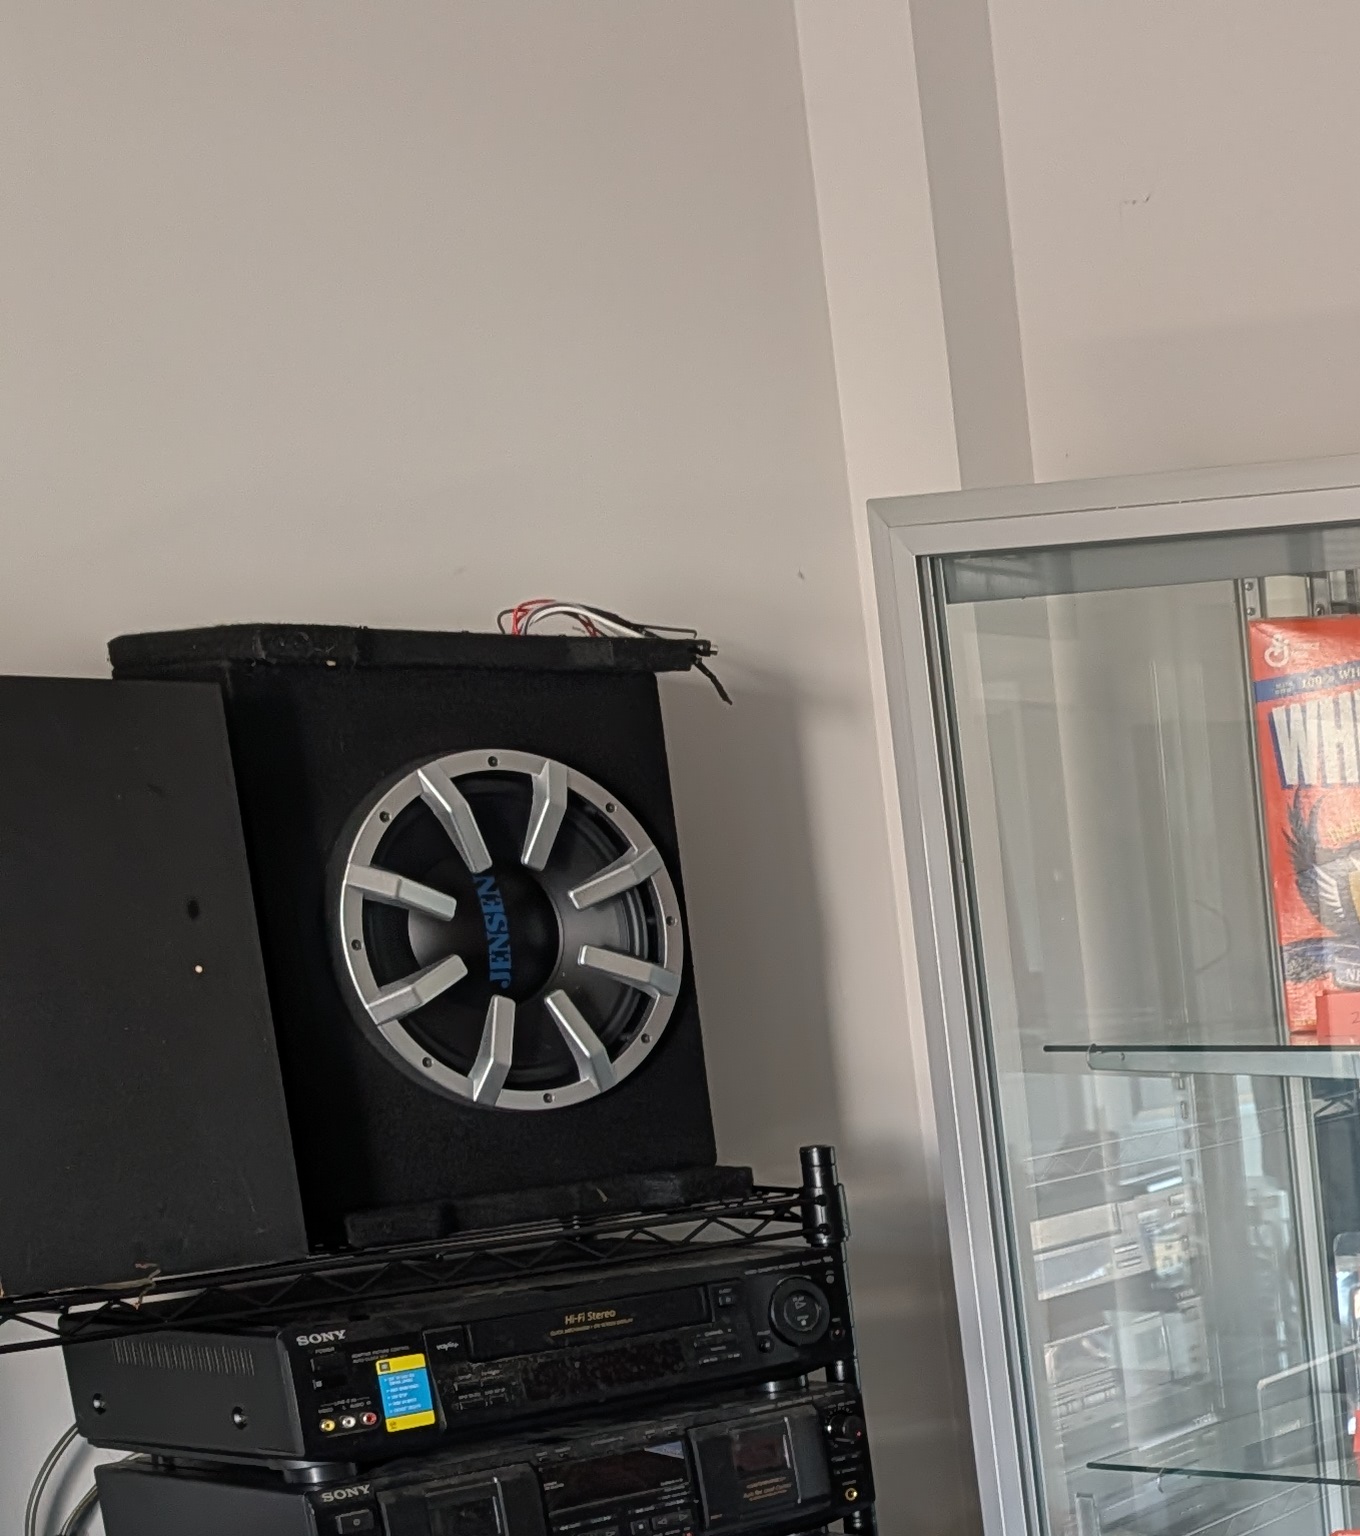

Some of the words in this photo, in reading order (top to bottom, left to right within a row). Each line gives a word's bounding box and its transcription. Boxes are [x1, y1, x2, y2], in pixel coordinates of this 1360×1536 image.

[472, 875, 512, 989] JENSEN
[564, 1311, 586, 1326] Hi-Fi
[587, 1309, 617, 1322] Stereo
[295, 1329, 346, 1347] SONY
[321, 1484, 371, 1503] SONY
